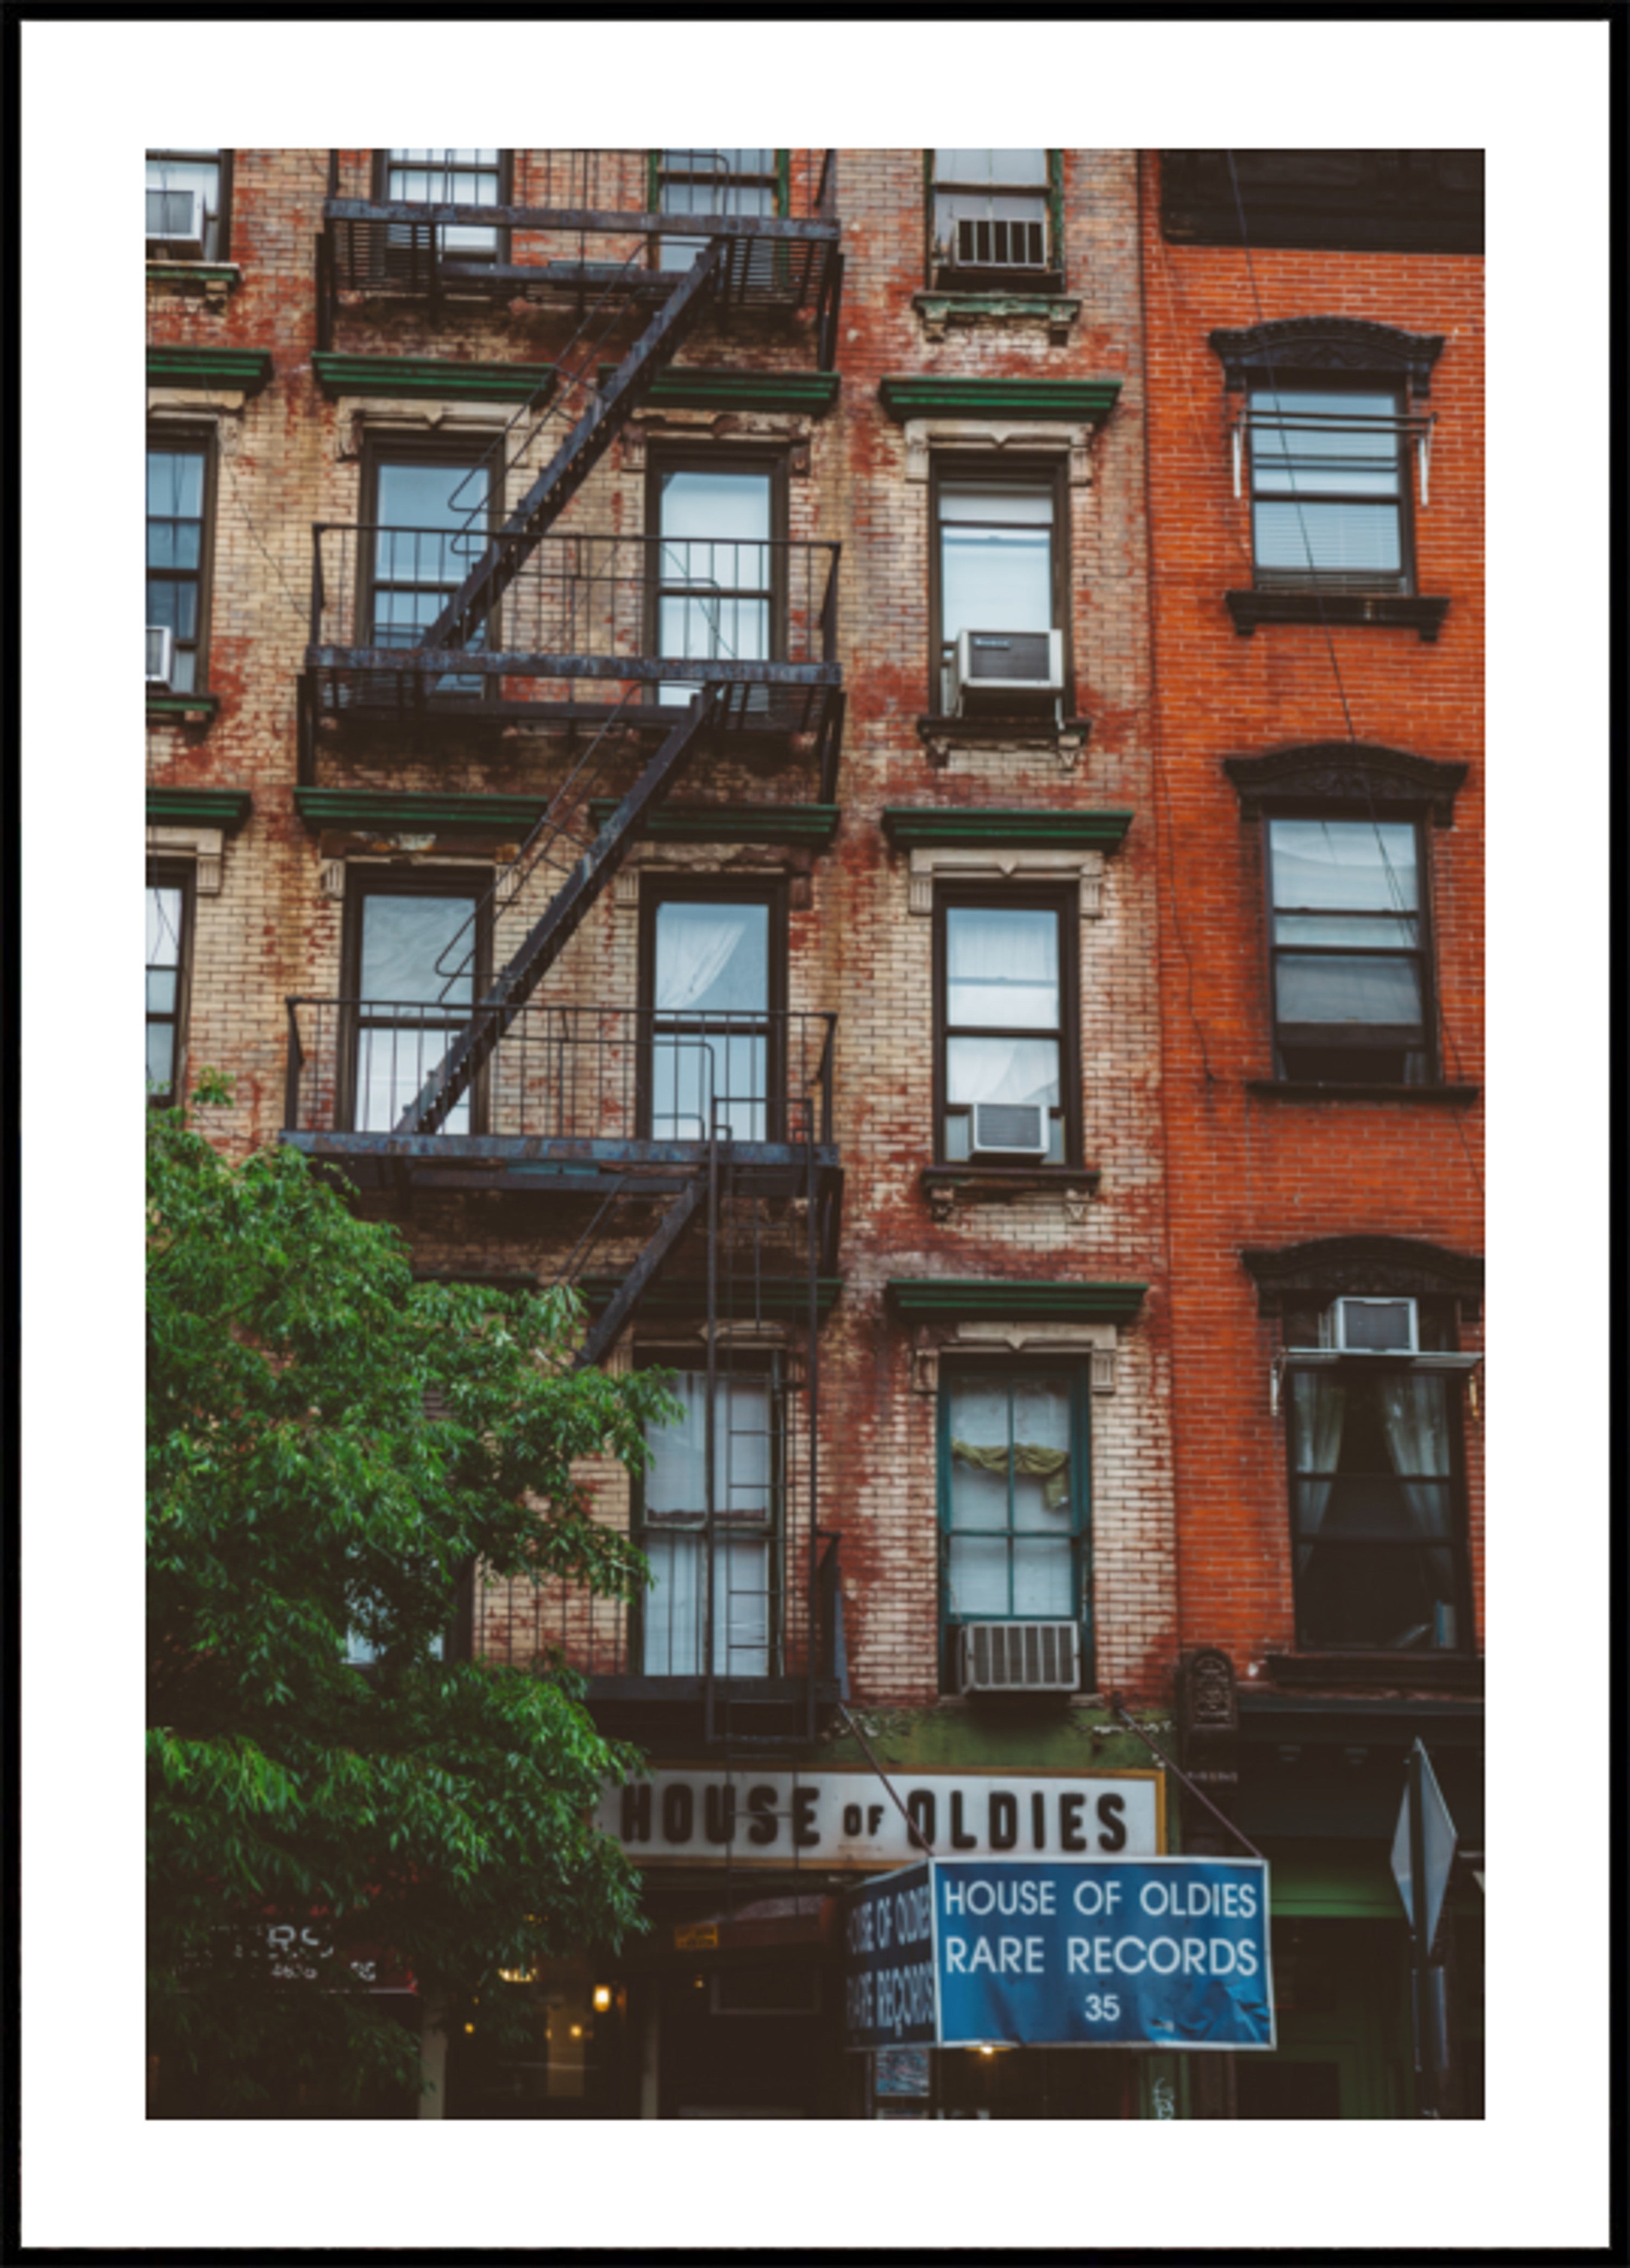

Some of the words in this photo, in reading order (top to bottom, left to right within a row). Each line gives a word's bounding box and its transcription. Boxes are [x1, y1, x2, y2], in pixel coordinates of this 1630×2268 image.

[620, 1783, 820, 1847] HOUSE
[843, 1804, 884, 1837] OF
[907, 1789, 1126, 1852] OLDIES
[944, 1881, 1055, 1915] HOUSE
[1074, 1881, 1121, 1916] OF
[1139, 1881, 1257, 1919] OLDIES
[946, 1936, 1044, 1973] RARE
[1068, 1935, 1258, 1976] RECORDS
[1085, 1994, 1120, 2021] 35
